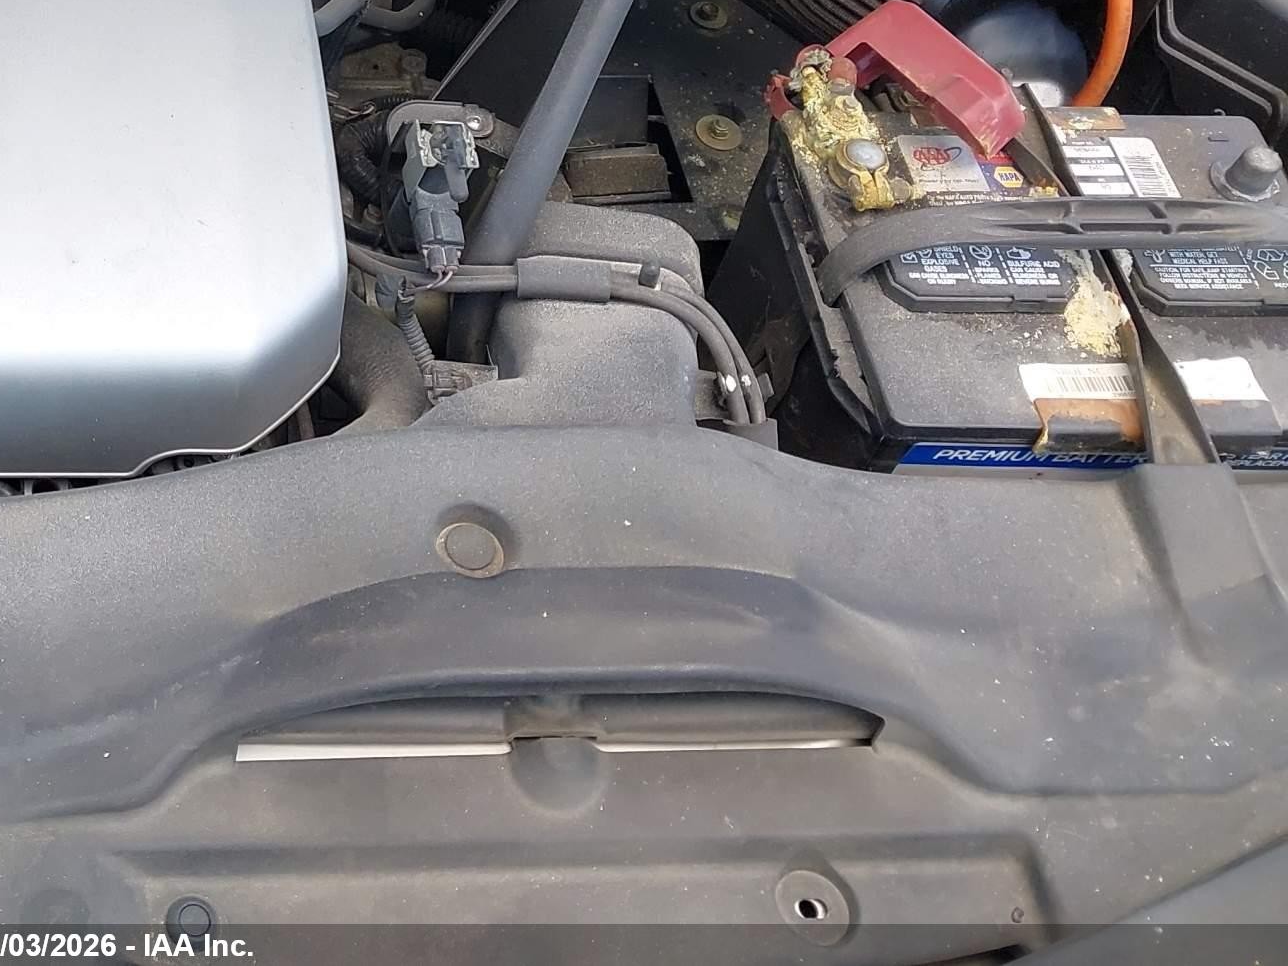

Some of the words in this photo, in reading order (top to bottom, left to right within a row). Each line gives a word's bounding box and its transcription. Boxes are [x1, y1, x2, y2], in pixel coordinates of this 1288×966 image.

[998, 172, 1020, 183] NAPA
[921, 258, 960, 266] EXPLOSIVE
[1007, 260, 1041, 268] SULFURIC
[933, 449, 1047, 462] PREMIUM
[1050, 452, 1148, 464] BATTER
